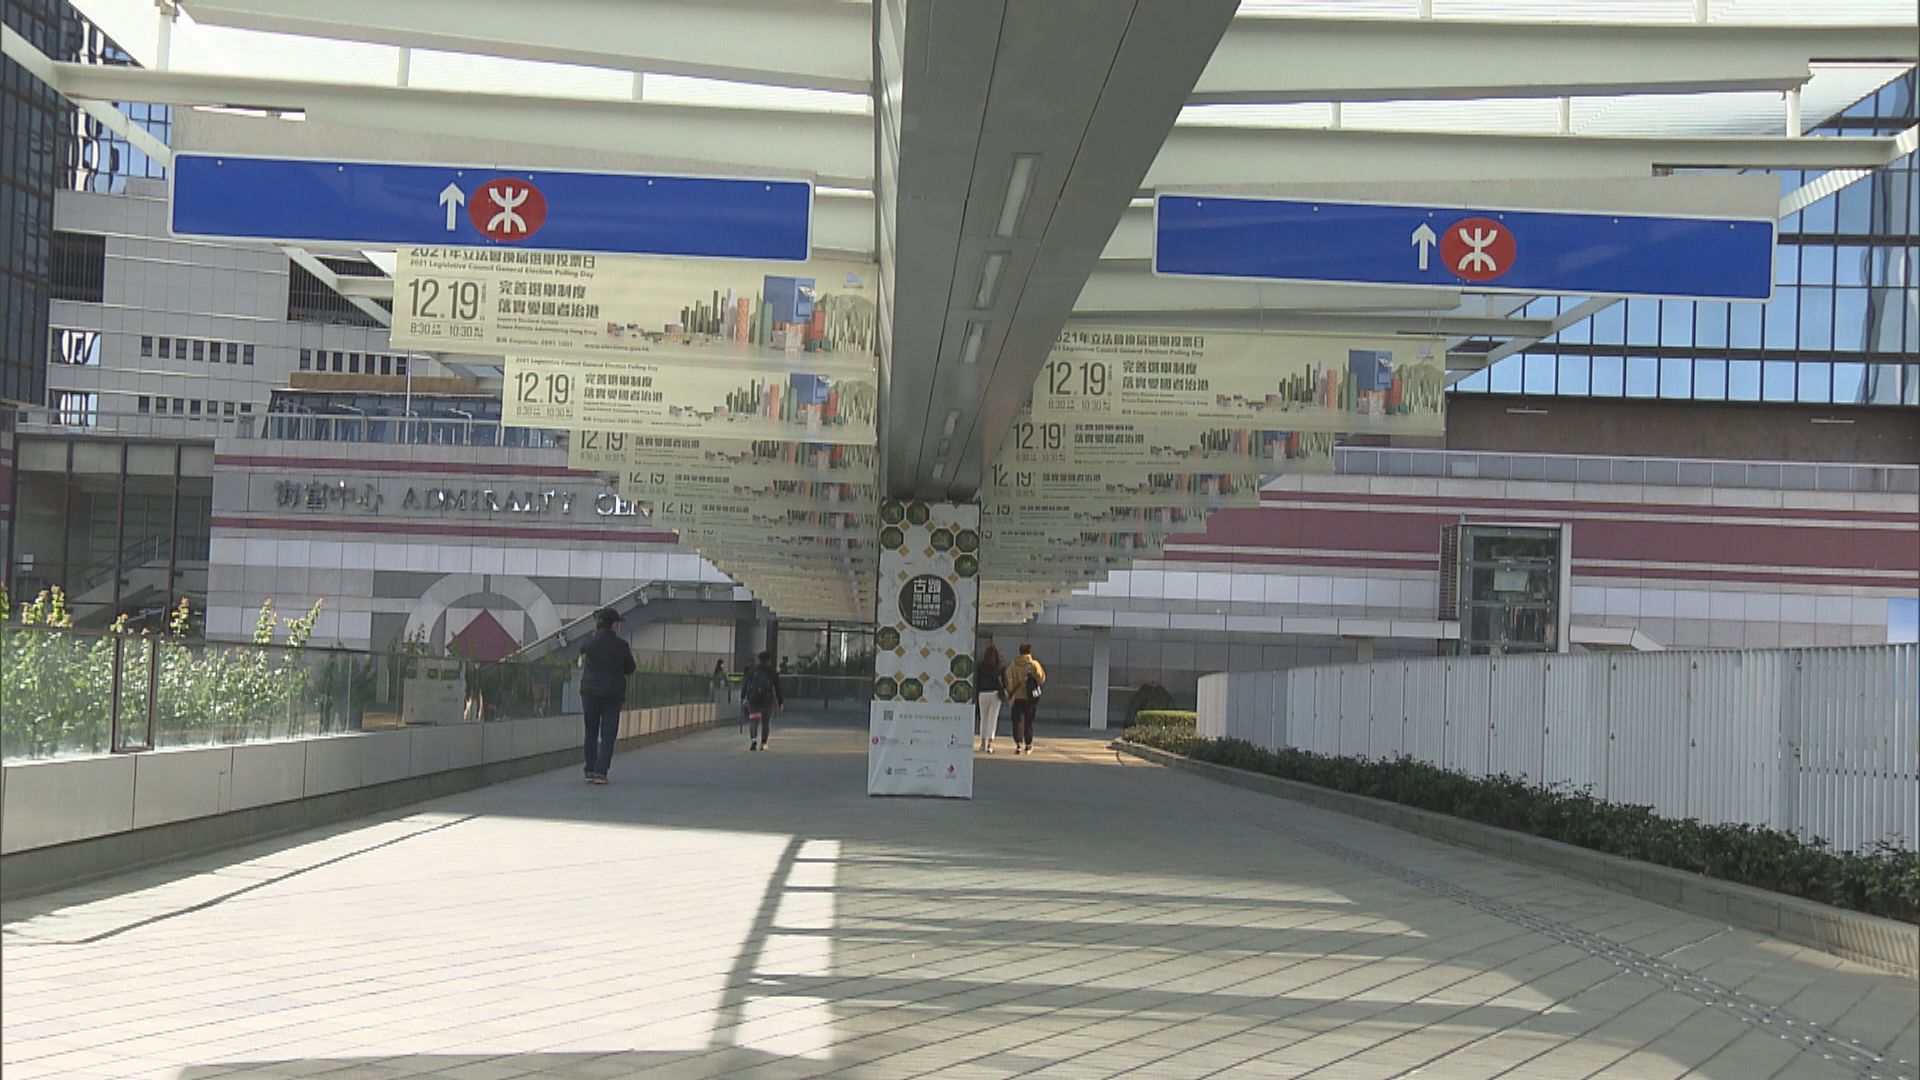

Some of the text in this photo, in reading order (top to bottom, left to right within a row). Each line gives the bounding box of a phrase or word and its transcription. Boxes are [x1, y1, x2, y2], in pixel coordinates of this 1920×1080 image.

[468, 262, 494, 272] Council
[495, 264, 523, 274] General
[525, 266, 552, 275] Election
[554, 268, 578, 278] Polling
[580, 270, 594, 279] Day
[402, 487, 577, 515] ADMIRALTY
